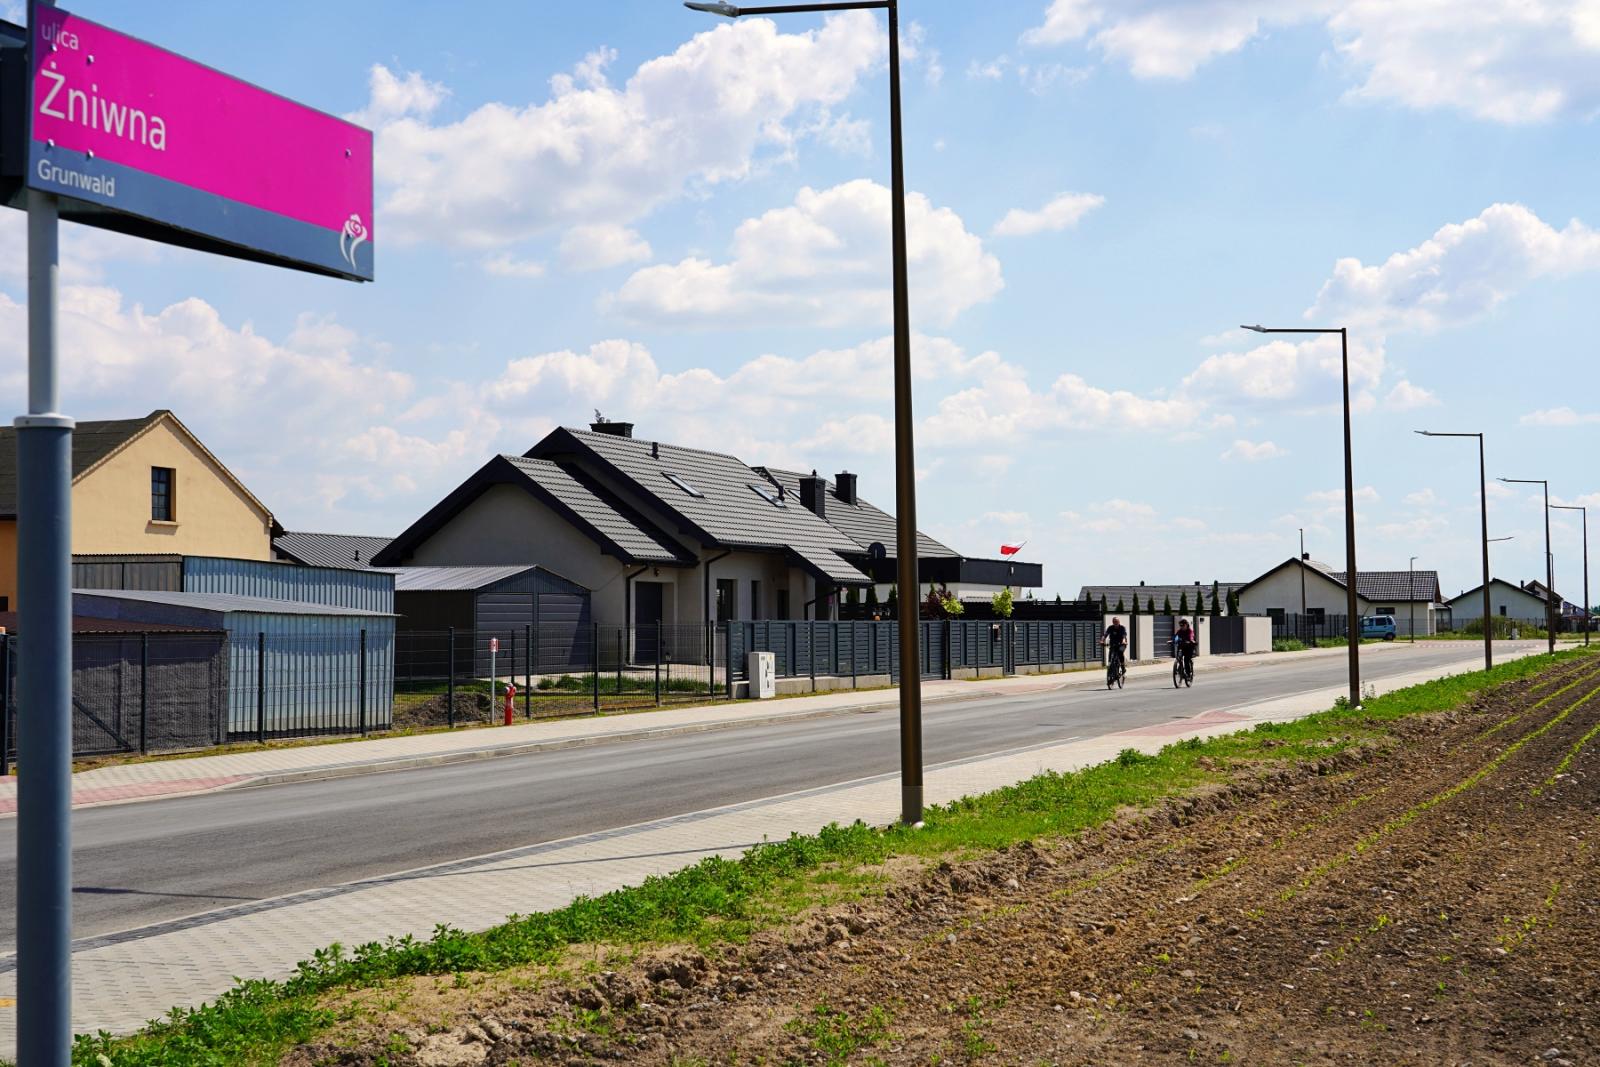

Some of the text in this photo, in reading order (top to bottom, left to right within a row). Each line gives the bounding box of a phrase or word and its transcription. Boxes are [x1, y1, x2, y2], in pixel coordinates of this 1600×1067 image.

[41, 22, 79, 50] ulica
[39, 62, 166, 151] Żniwna
[37, 159, 115, 197] Grunwald
